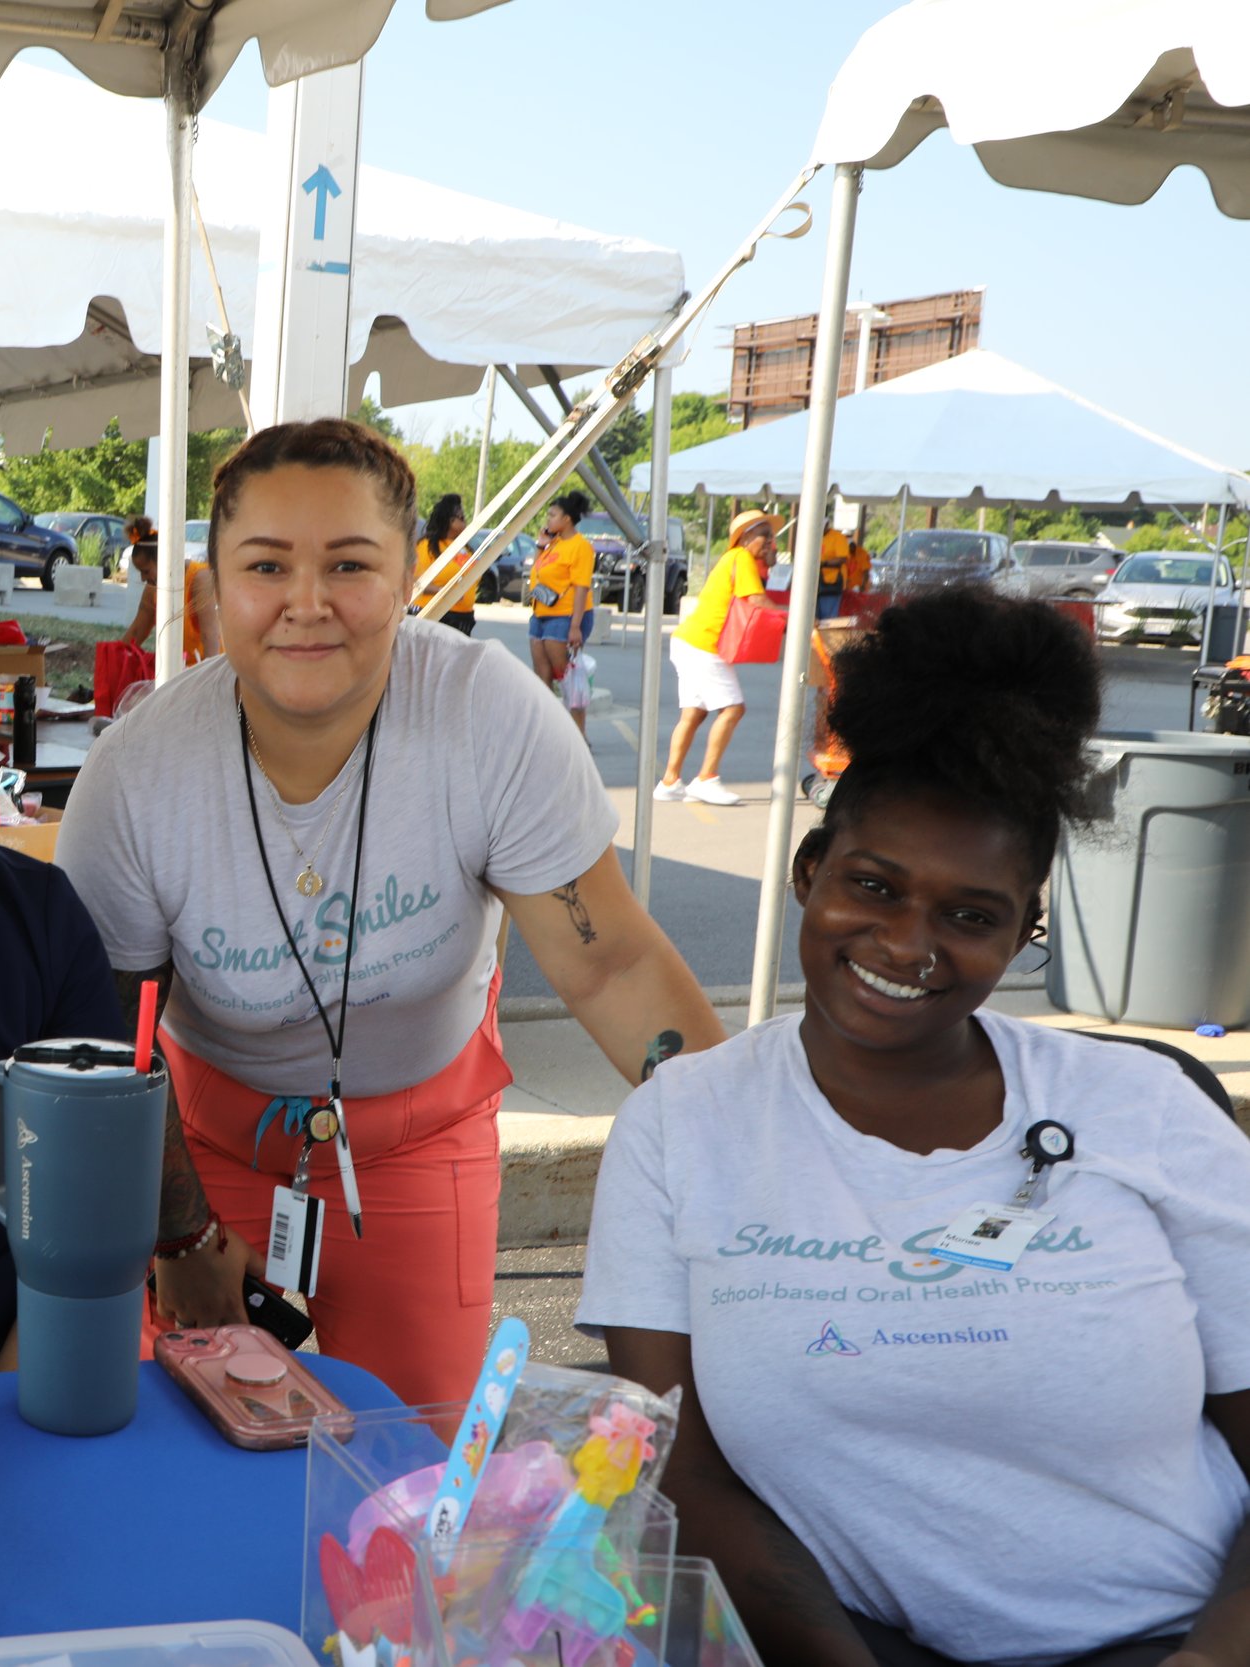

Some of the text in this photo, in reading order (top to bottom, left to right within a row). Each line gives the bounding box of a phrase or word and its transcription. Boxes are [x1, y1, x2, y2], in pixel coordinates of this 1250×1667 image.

[192, 874, 441, 972] Smart Smiles
[334, 960, 389, 984] Health
[393, 922, 460, 967] Program
[21, 1155, 33, 1240] Ascension
[717, 1223, 885, 1263] Smart
[711, 1276, 1118, 1306] School-based Oral Health Program
[871, 1326, 1010, 1345] Ascension
